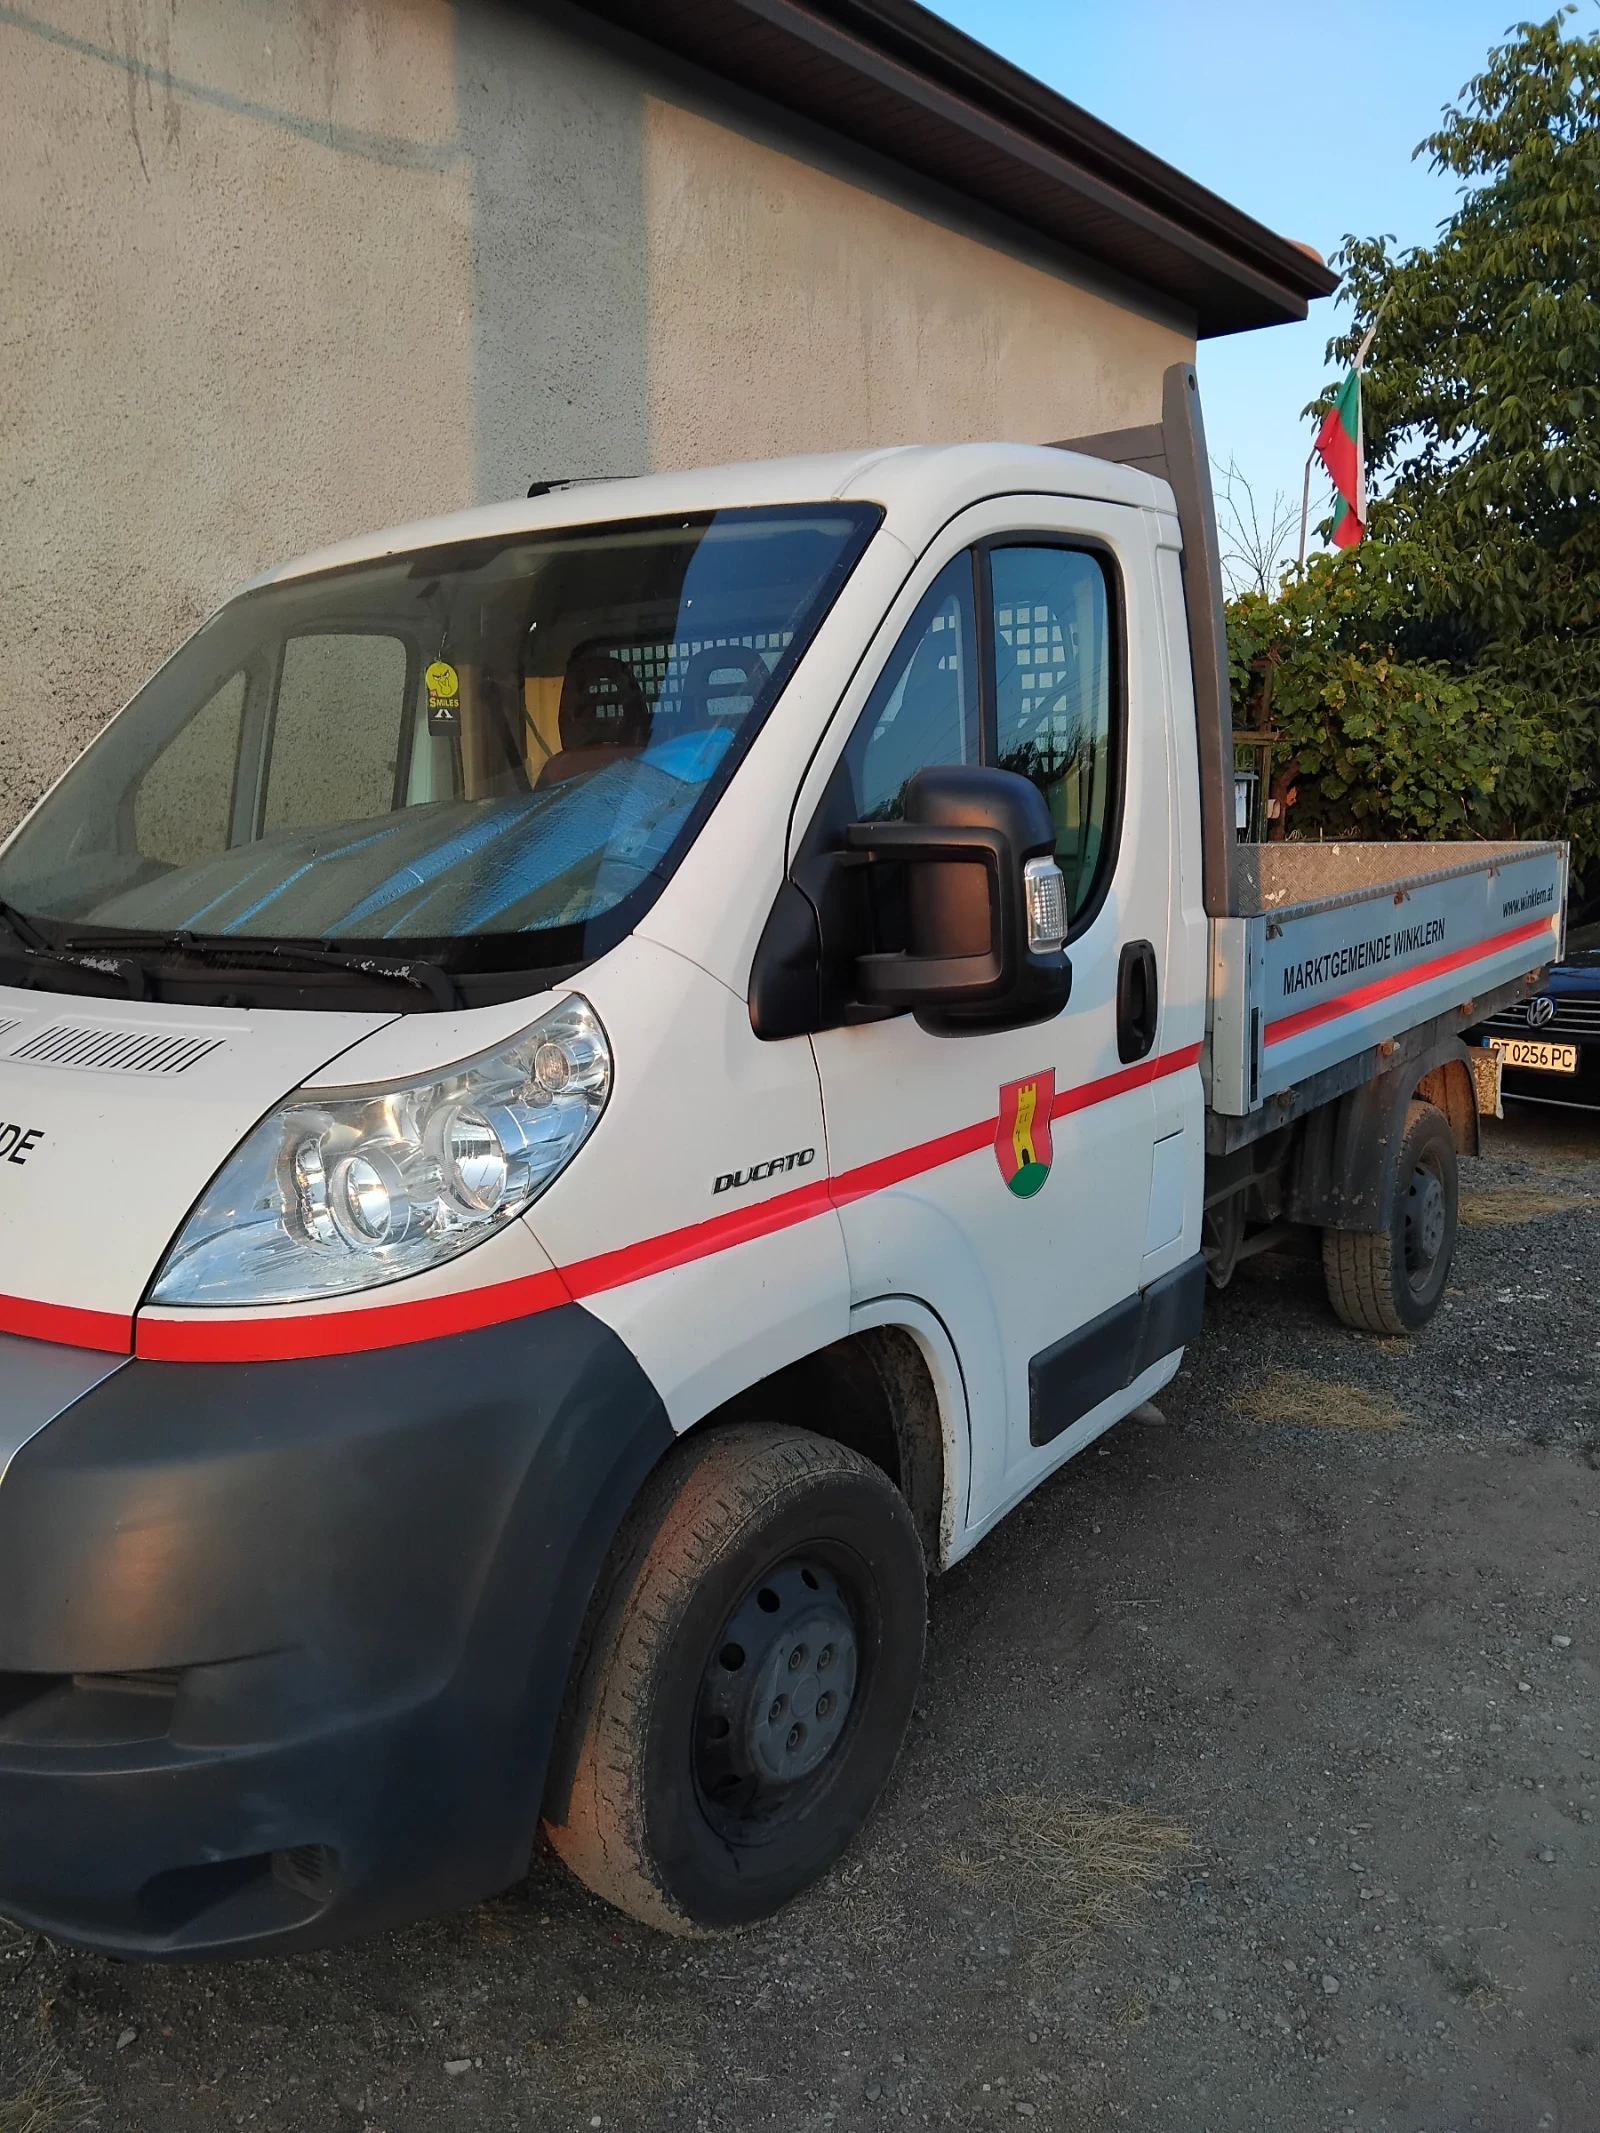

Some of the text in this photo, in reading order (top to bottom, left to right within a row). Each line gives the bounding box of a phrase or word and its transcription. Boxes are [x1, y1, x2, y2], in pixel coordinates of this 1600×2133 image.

[429, 697, 459, 708] SMILES
[1502, 883, 1554, 918] www.winklern.at
[1283, 917, 1446, 996] MARKTGEMEINDE WINKLERN
[1512, 1044, 1549, 1066] 0256
[1551, 1048, 1573, 1068] PC
[0, 1121, 46, 1165] DE
[711, 1147, 815, 1195] DUCATO
